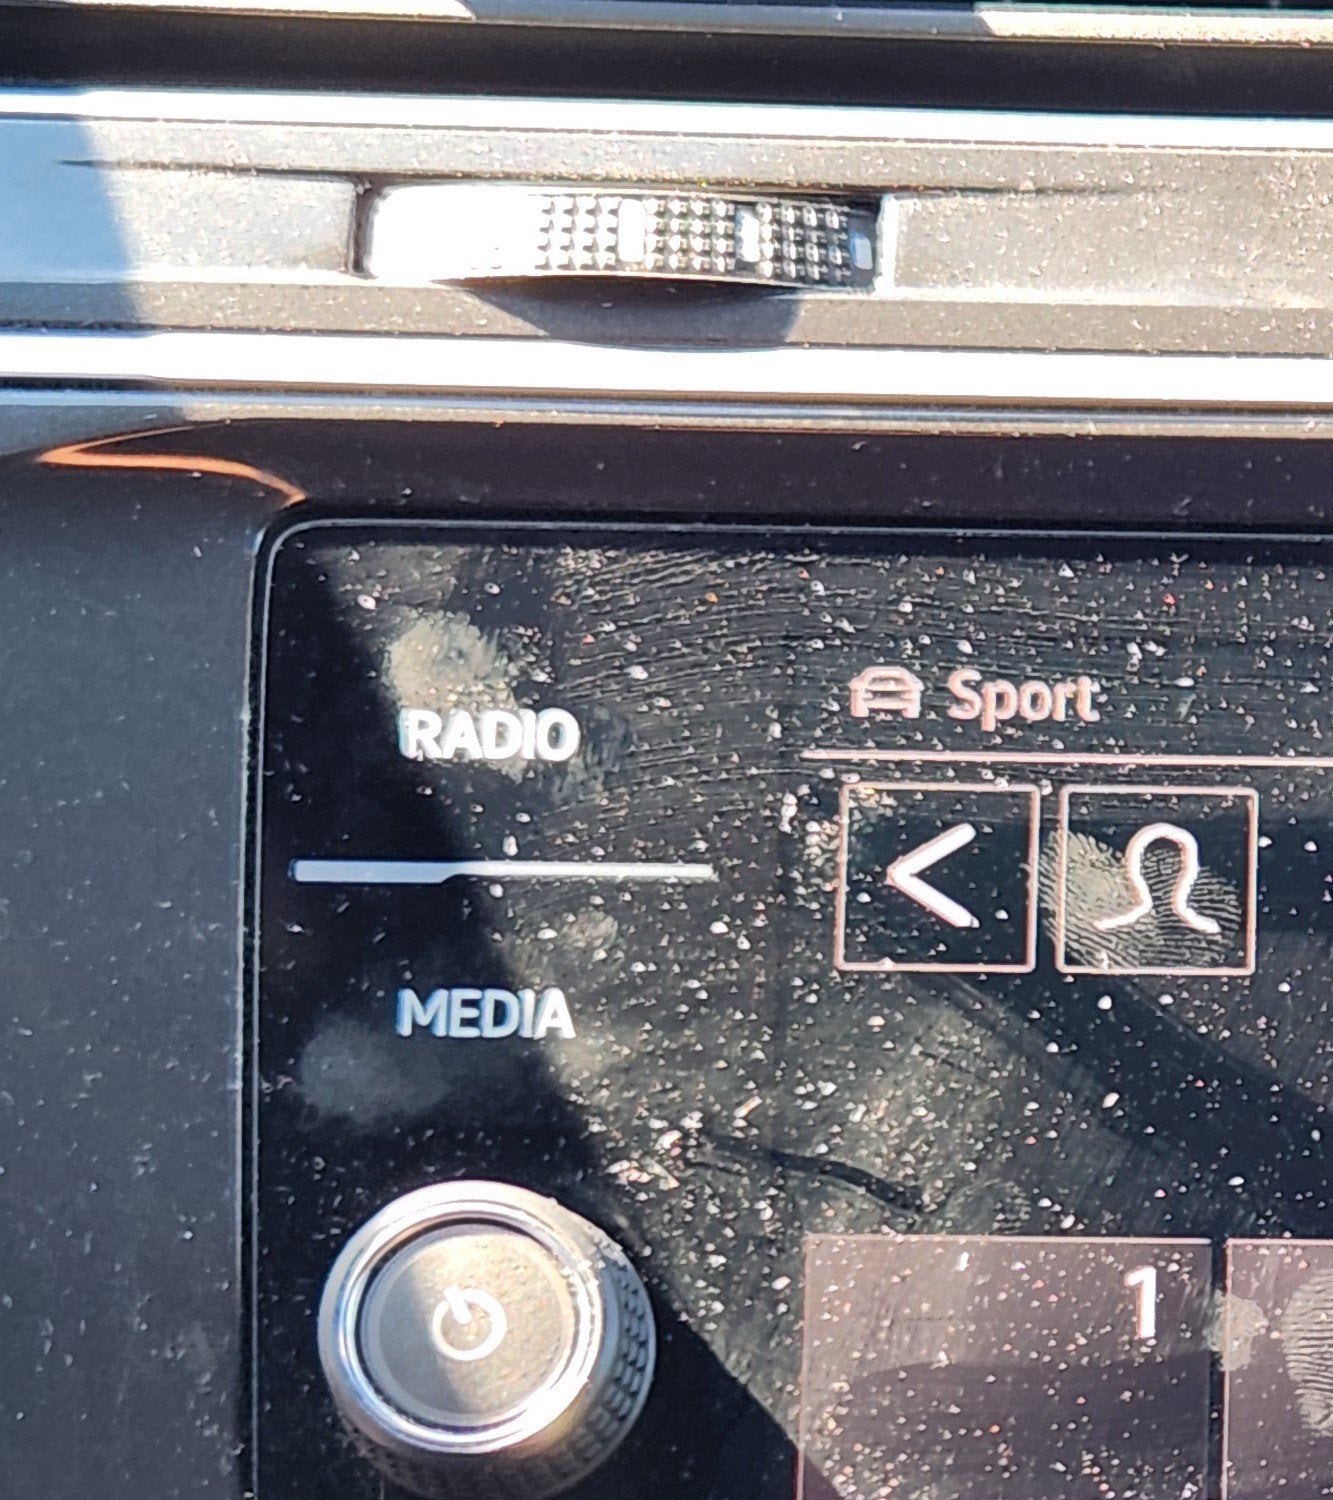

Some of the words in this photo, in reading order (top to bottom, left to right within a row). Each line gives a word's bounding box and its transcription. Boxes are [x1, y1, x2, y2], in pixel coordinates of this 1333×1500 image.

[947, 668, 1100, 730] Sport
[400, 708, 581, 762] RADIO
[395, 987, 576, 1040] MEDIA
[1124, 1265, 1160, 1339] 1
